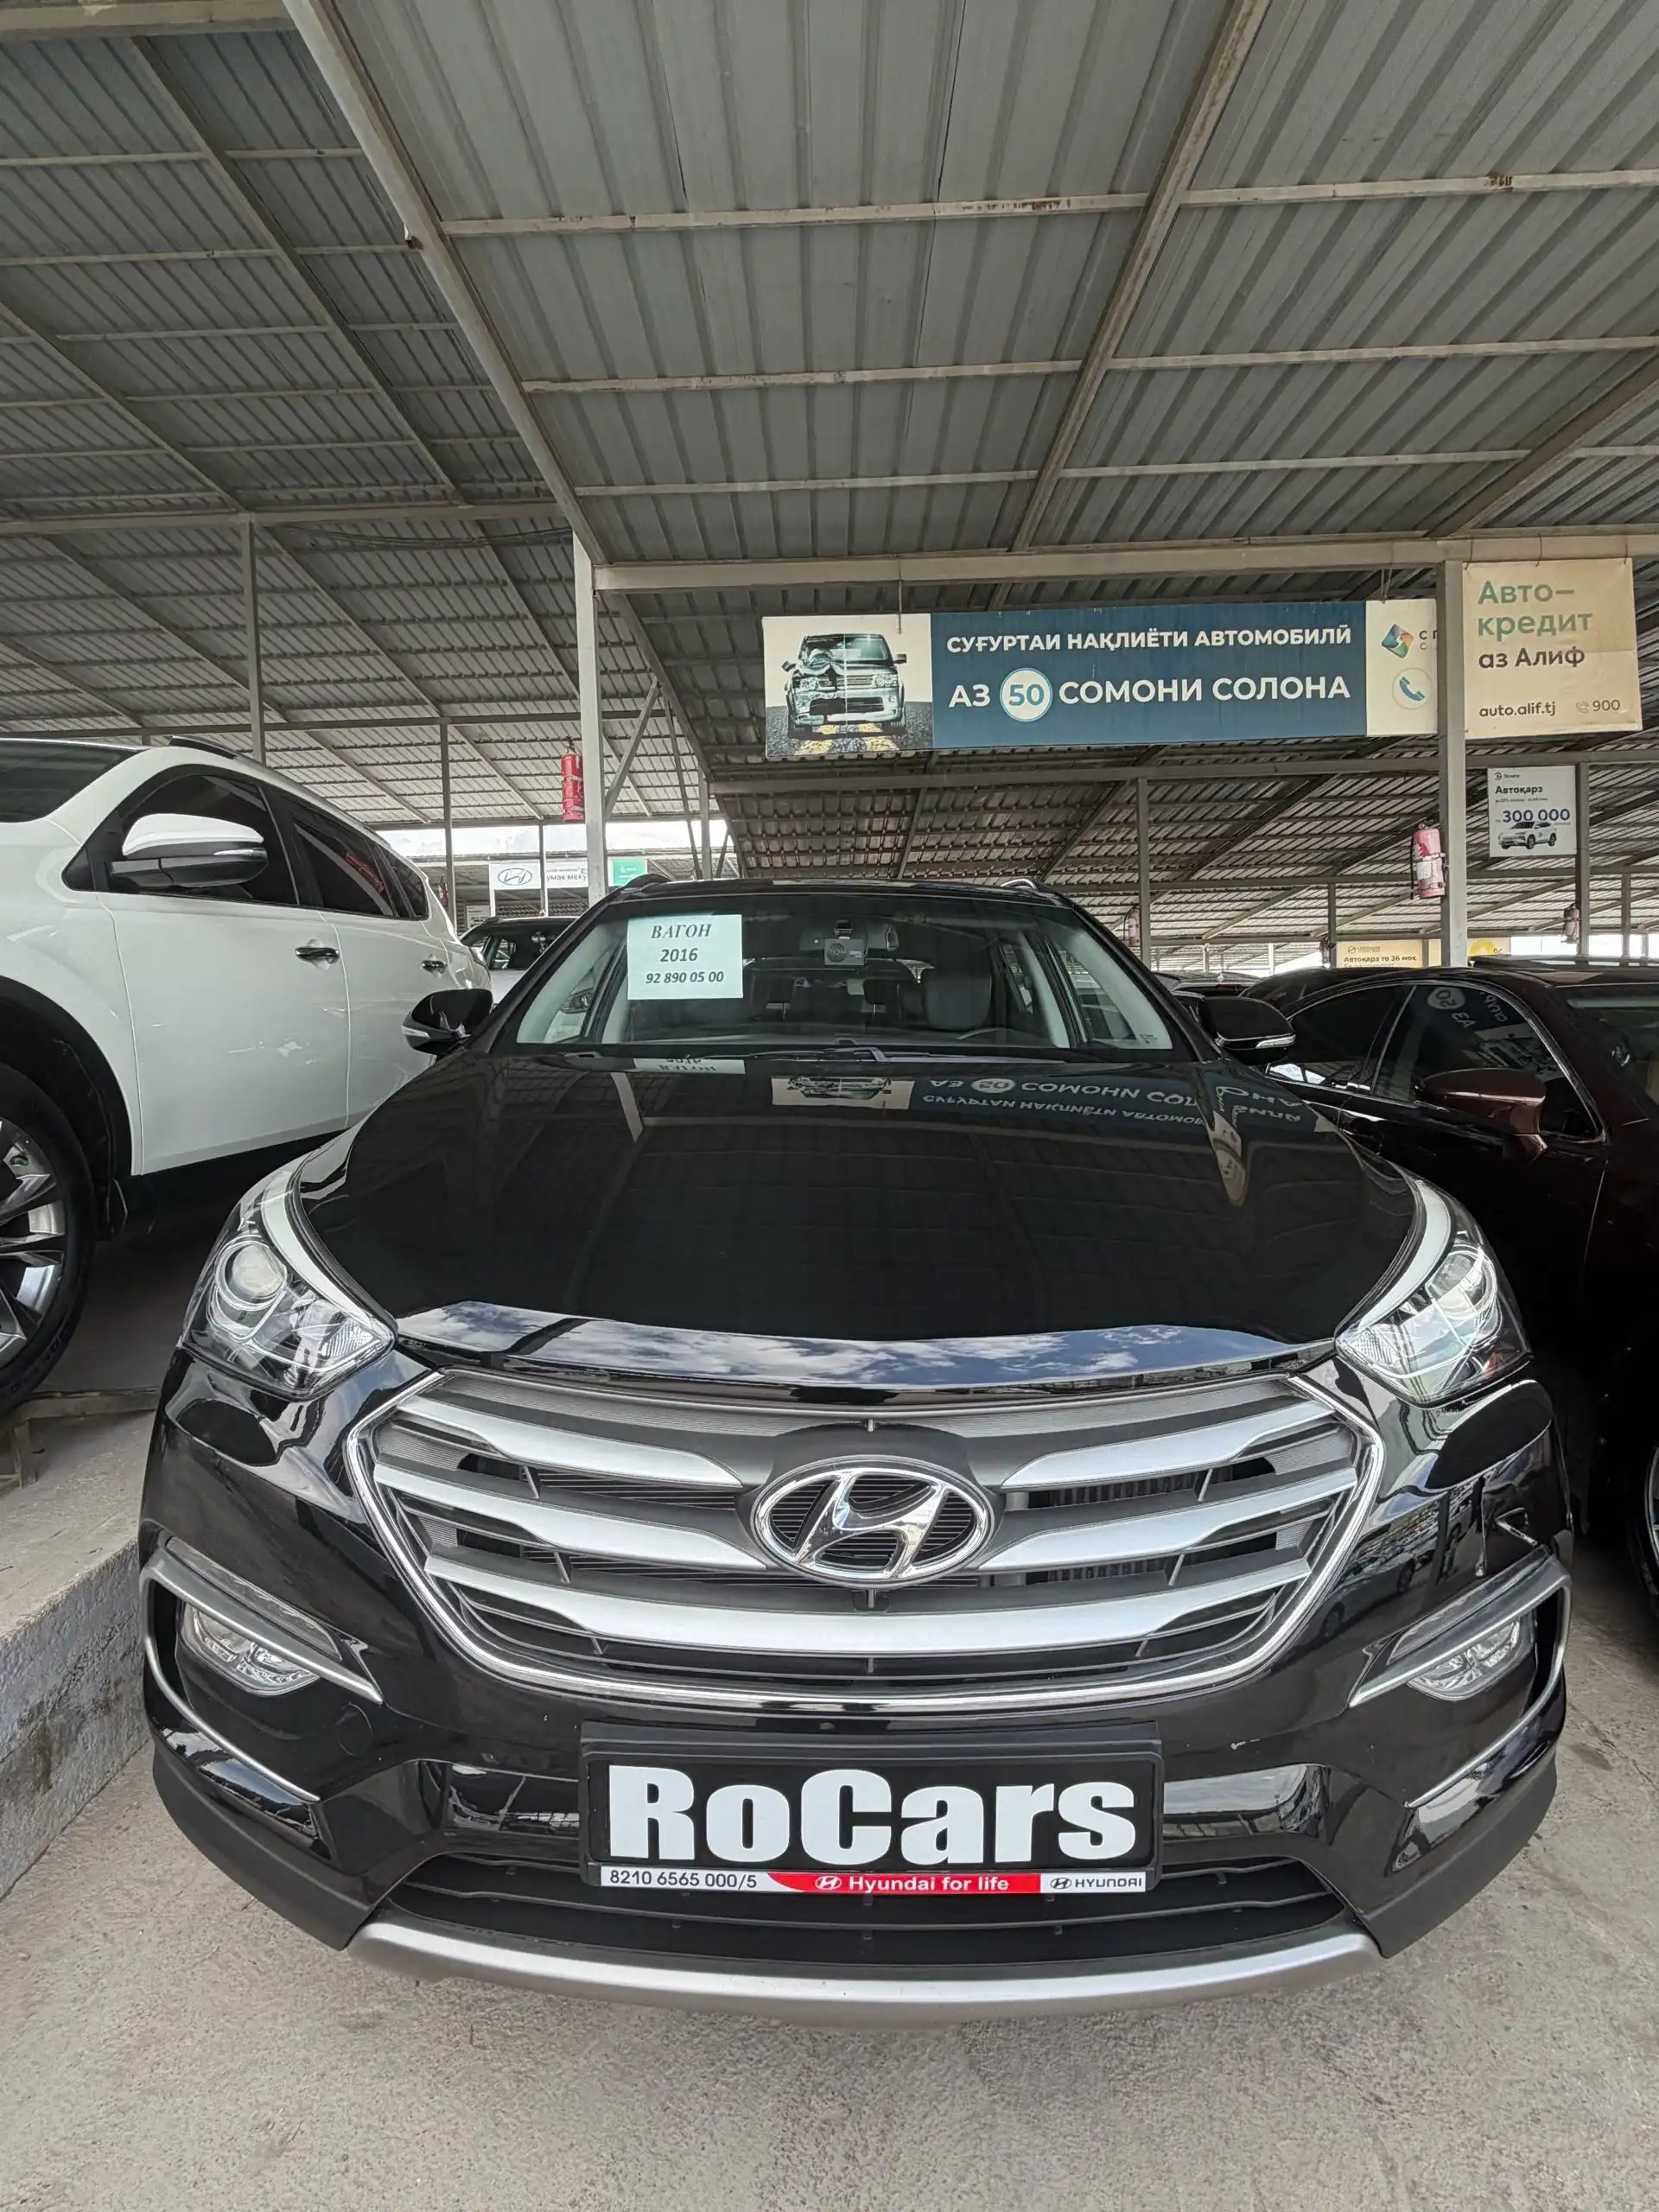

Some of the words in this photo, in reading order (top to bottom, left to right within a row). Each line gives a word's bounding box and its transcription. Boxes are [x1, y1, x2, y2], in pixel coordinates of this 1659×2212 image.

[1478, 613, 1593, 642] кредит
[946, 633, 1061, 653] СУҒУРТАИ
[1067, 628, 1188, 651] НАҚЛИЁТИ
[1478, 652, 1509, 669] аз
[1514, 645, 1586, 668] Алиф
[949, 683, 991, 708] АЗ
[1008, 683, 1045, 707] 50
[1058, 678, 1203, 705] СОМОНИ
[1211, 676, 1351, 702] СОЛОНА
[1478, 702, 1556, 718] auto.alif.tj
[1592, 699, 1621, 712] 900
[1502, 809, 1534, 823] 300
[1537, 808, 1571, 822] 000
[651, 924, 712, 939] ВАГОН
[660, 947, 699, 963] 2016
[645, 973, 661, 984] 92
[664, 972, 687, 983] 890
[690, 971, 705, 982] 05
[709, 970, 724, 982] 00
[608, 1764, 1135, 1866] RoCars
[609, 1870, 652, 1885] 8210
[657, 1872, 700, 1887] 6565
[705, 1872, 757, 1891] 000/5
[849, 1876, 936, 1893] Hyundai
[942, 1876, 972, 1891] for
[978, 1876, 1009, 1891] life
[1075, 1878, 1142, 1889] HYUNDAI
